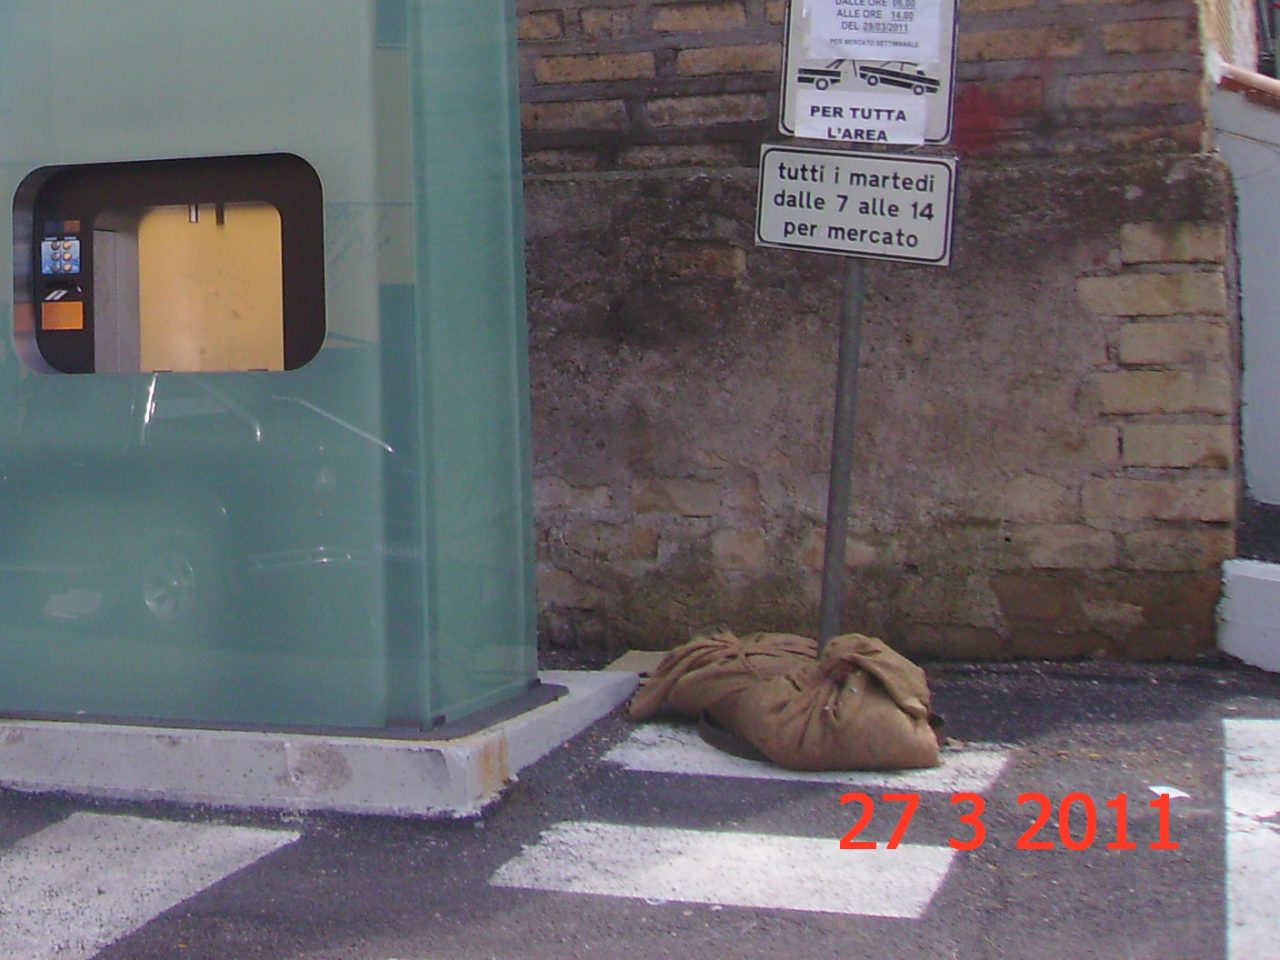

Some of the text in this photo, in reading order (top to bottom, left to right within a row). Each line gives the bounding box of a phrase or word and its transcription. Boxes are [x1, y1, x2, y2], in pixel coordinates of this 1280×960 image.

[837, 9, 860, 19] ALLE
[863, 10, 883, 19] ORE
[841, 21, 908, 33] DEL 29/03/2011
[810, 105, 907, 121] PER TUTTA
[827, 127, 888, 141] L'AREA
[778, 162, 935, 192] tutti i martedi
[773, 189, 934, 221] dalle 7 alle 14
[783, 221, 919, 248] per mercato
